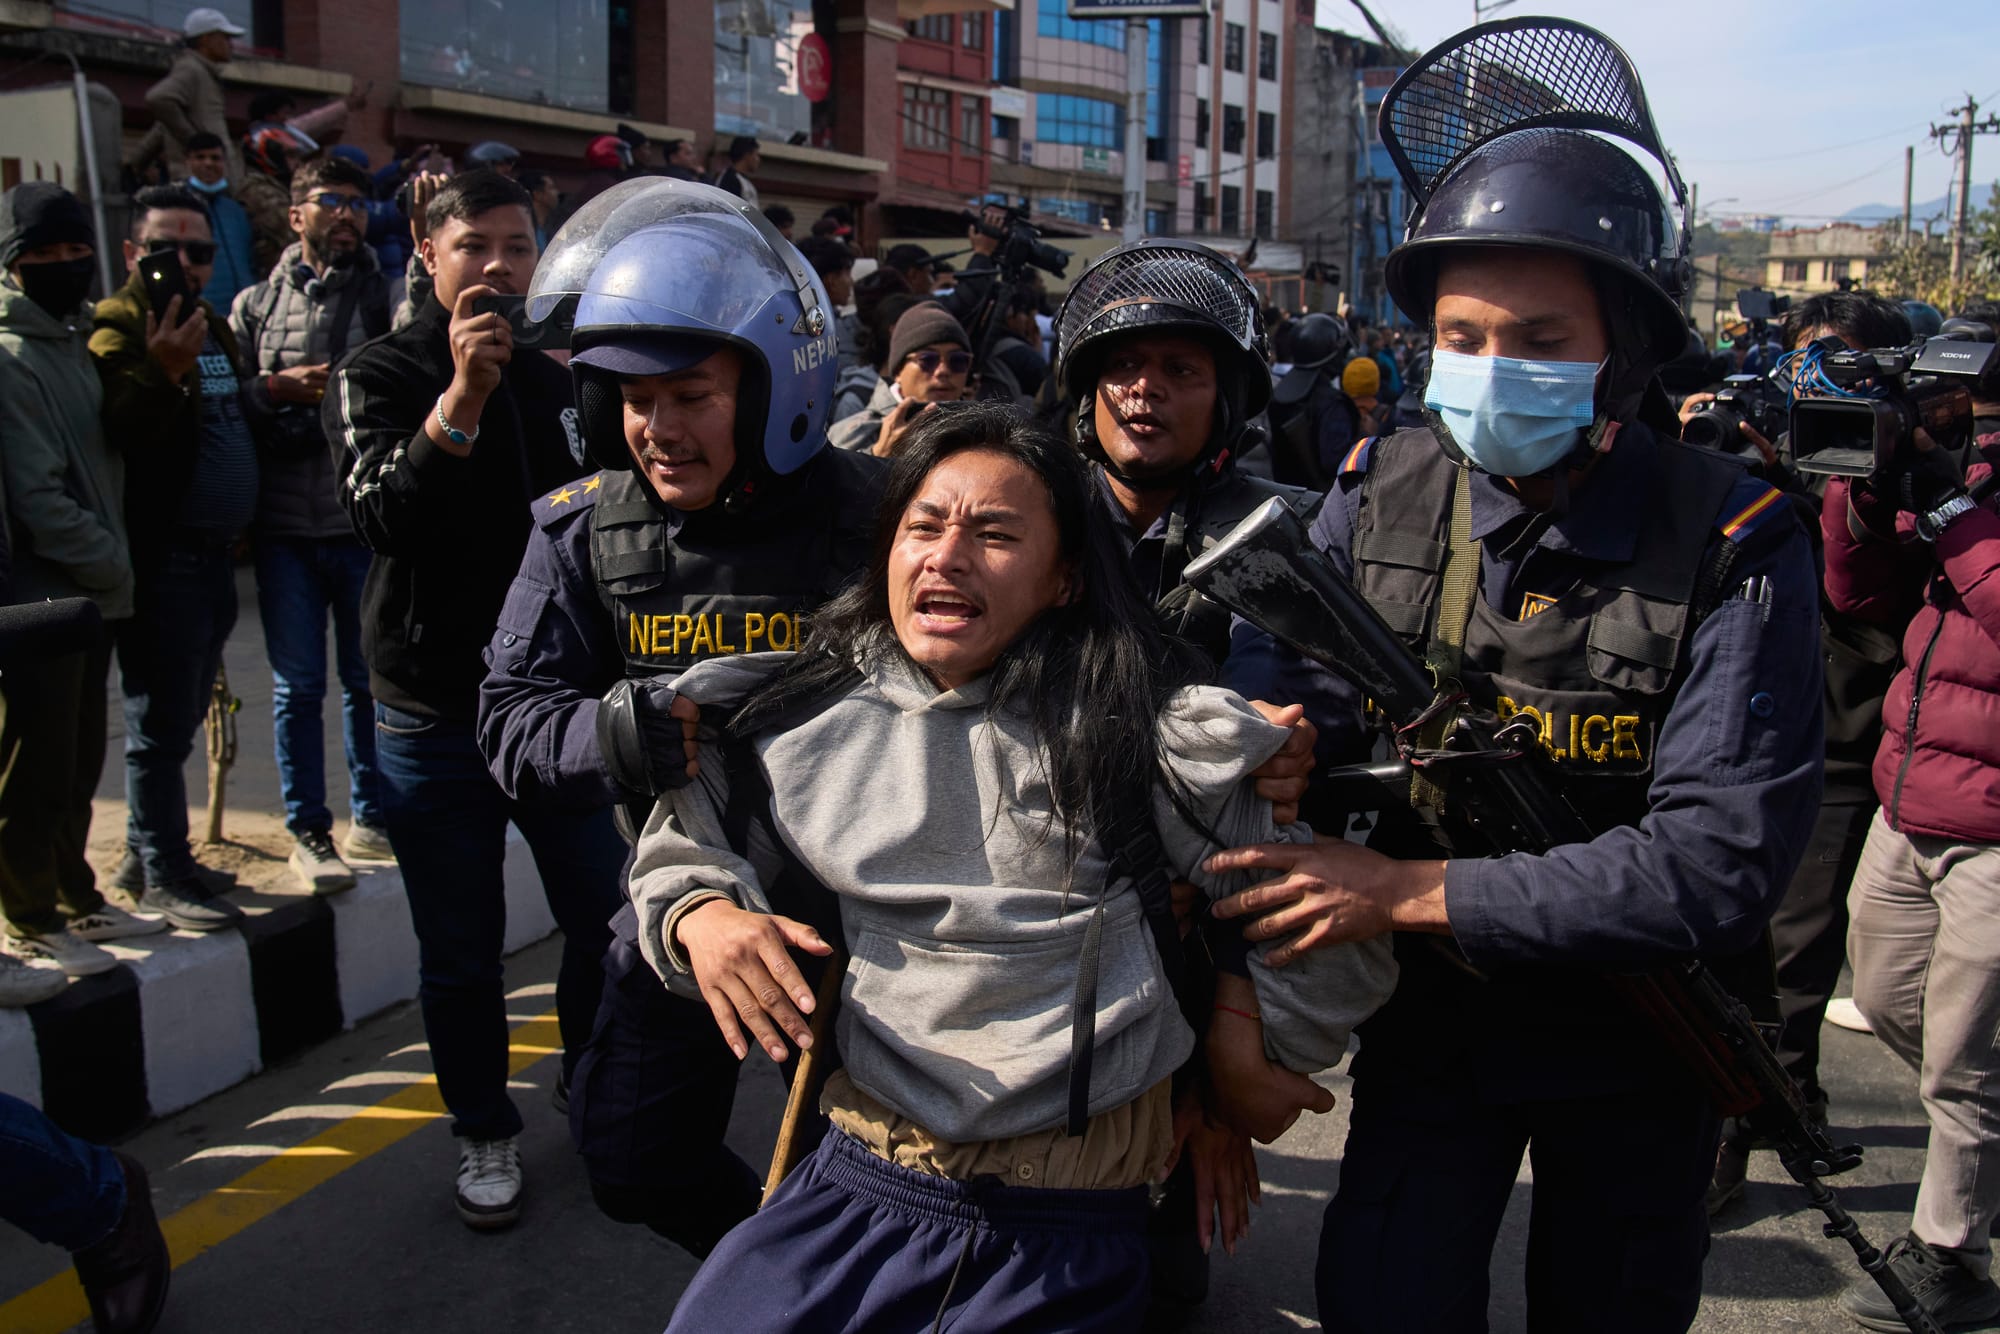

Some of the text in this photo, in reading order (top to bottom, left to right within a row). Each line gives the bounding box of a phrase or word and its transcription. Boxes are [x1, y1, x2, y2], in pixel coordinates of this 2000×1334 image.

[792, 335, 839, 375] NEPA
[629, 612, 802, 655] NEPAL POL
